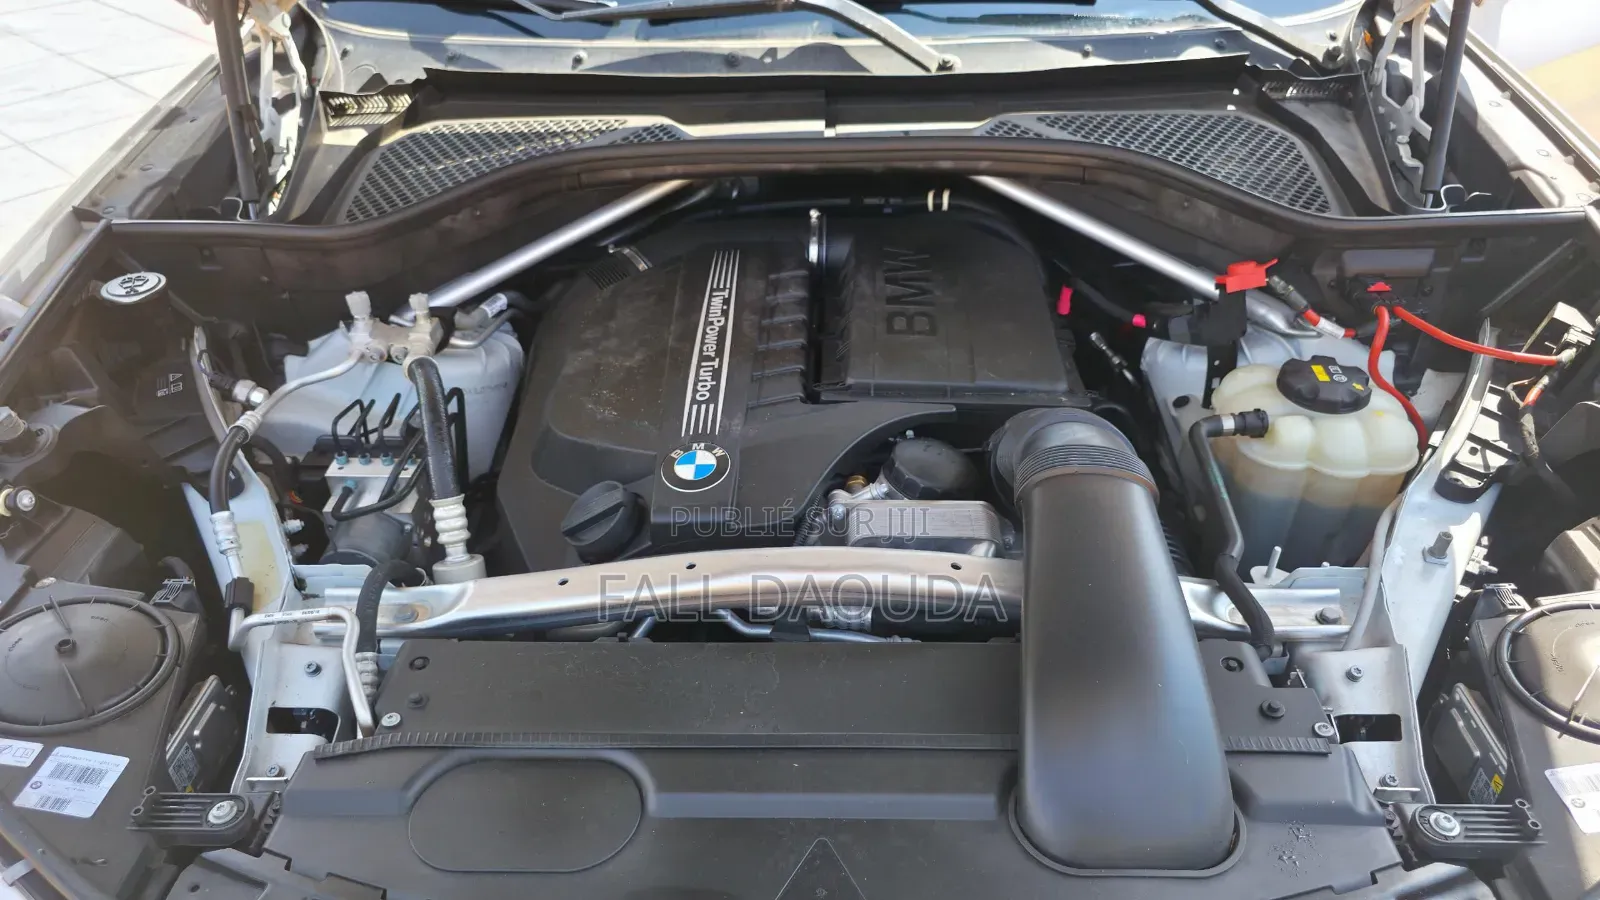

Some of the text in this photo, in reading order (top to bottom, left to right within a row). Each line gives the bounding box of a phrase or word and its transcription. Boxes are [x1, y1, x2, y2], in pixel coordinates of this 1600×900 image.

[883, 246, 938, 336] BMW
[695, 288, 730, 401] TwinPower Turbo
[670, 442, 726, 459] BMW
